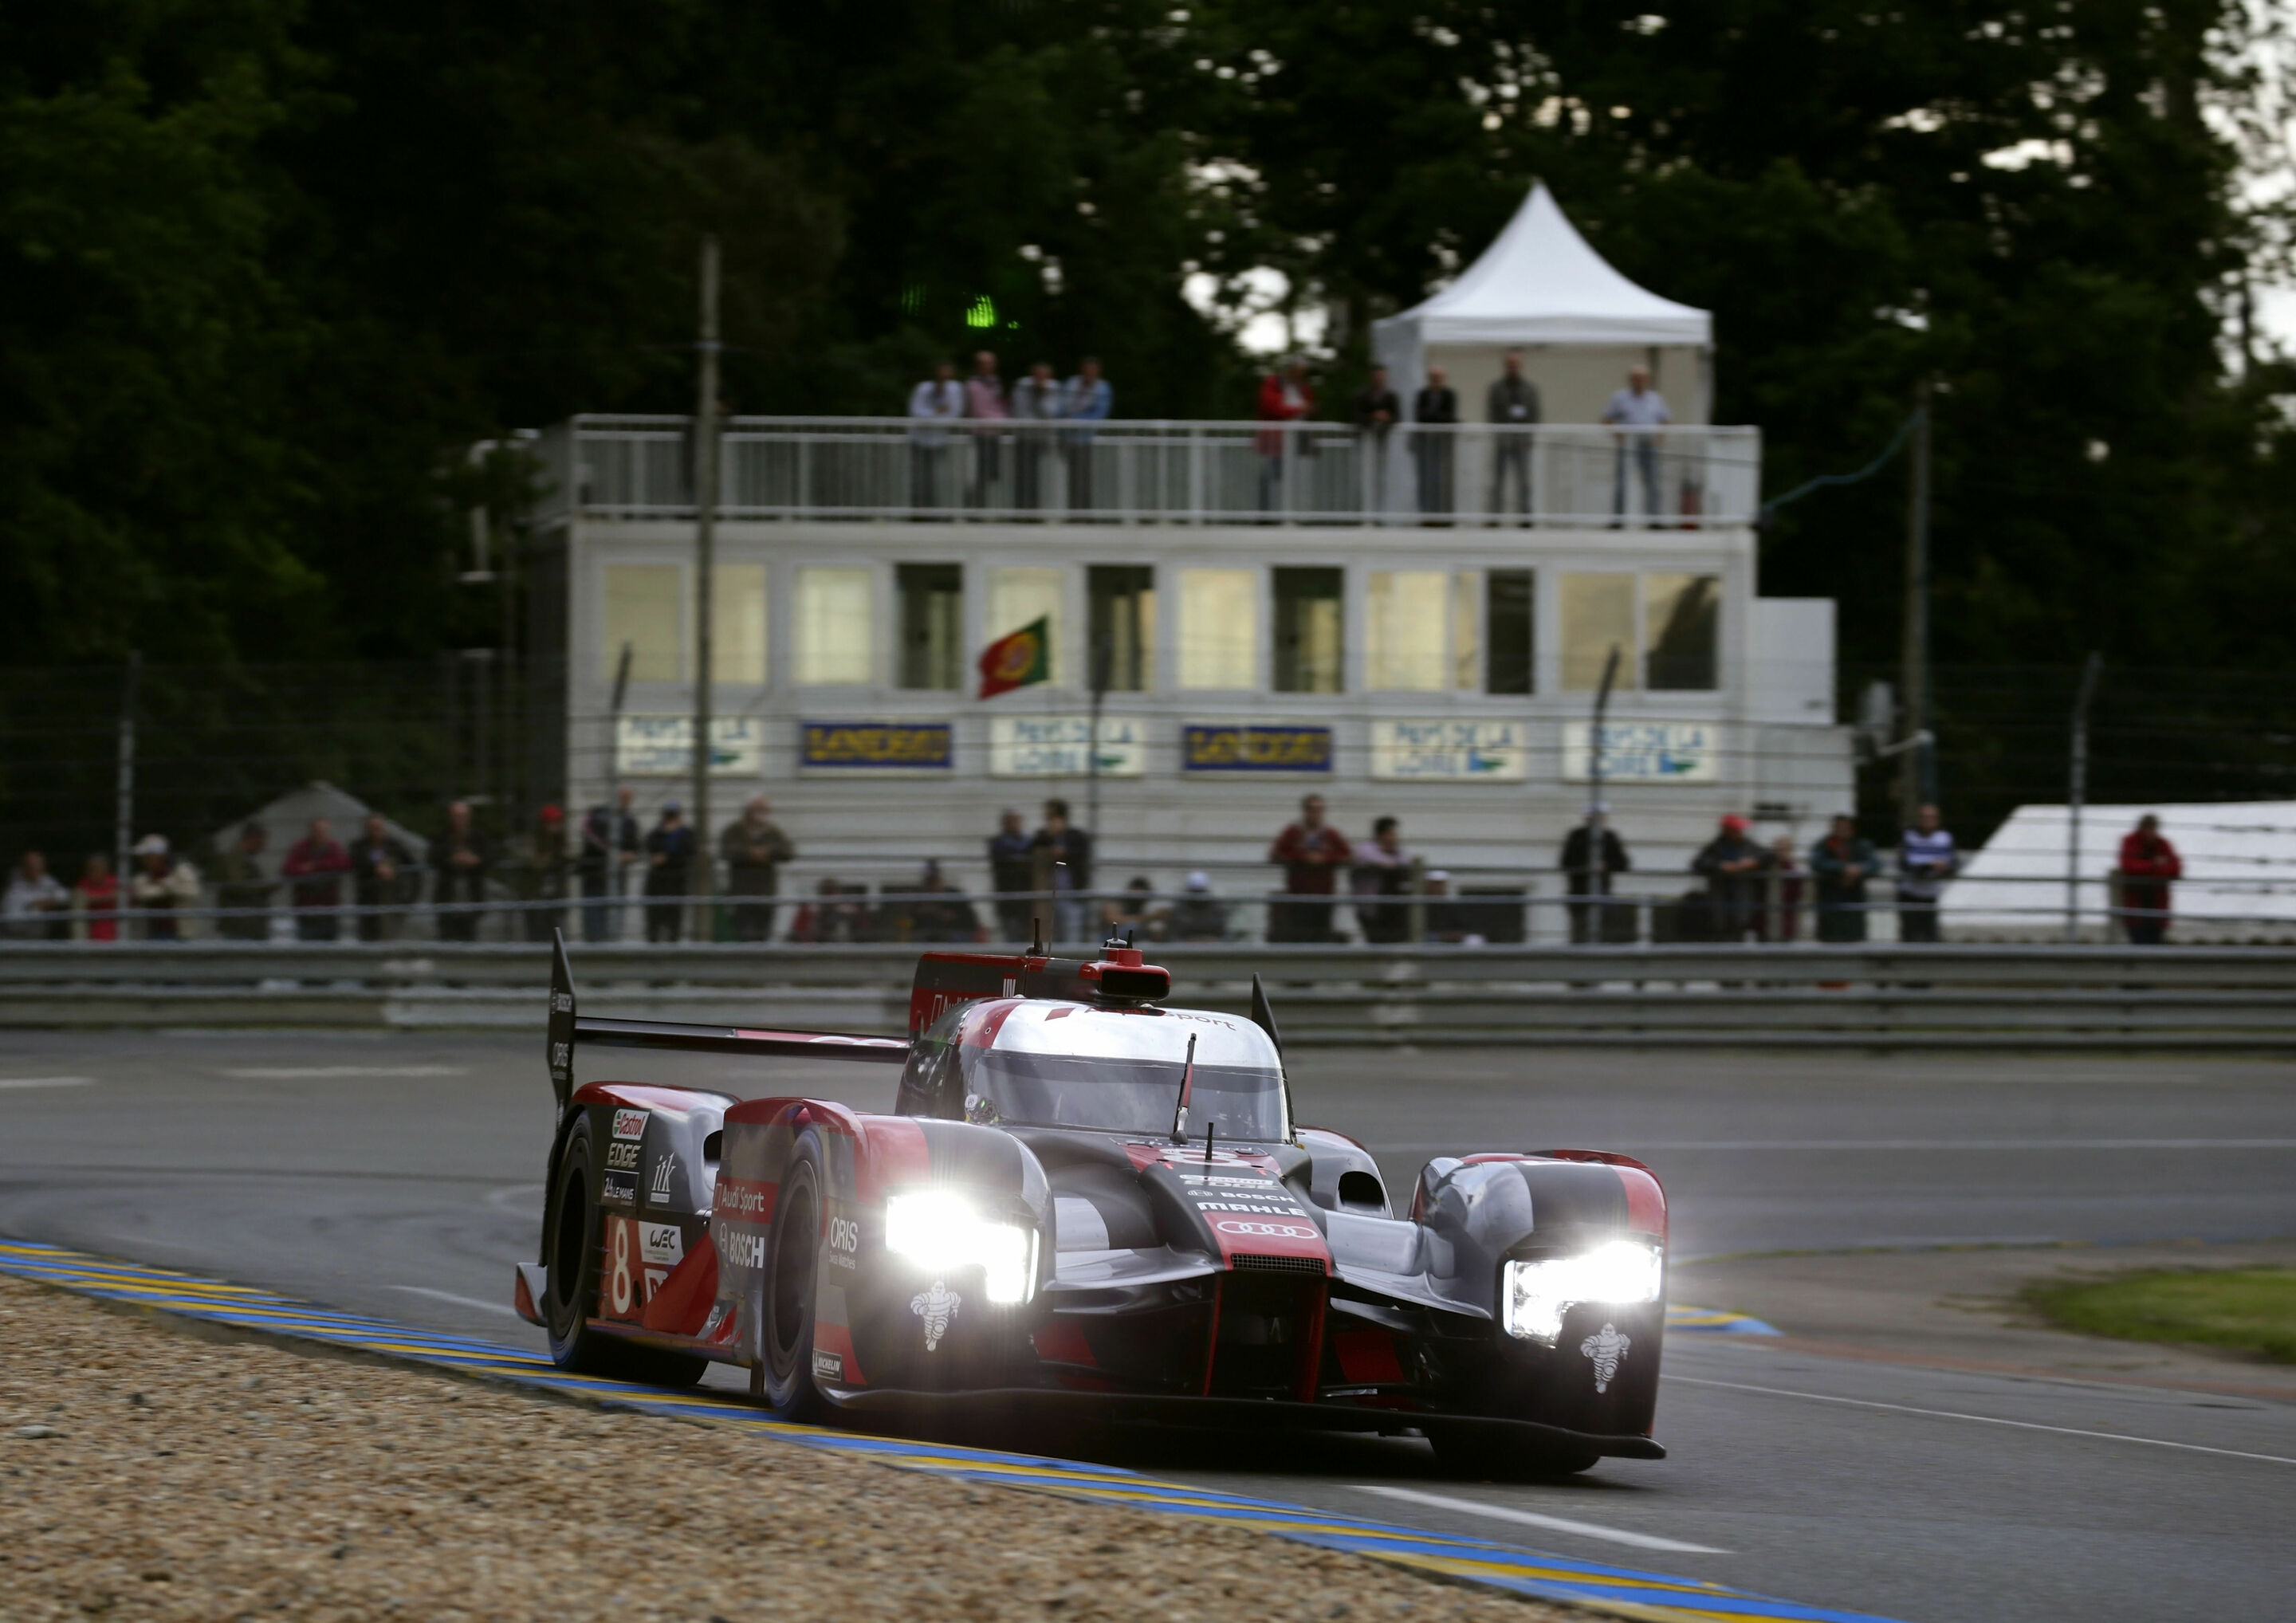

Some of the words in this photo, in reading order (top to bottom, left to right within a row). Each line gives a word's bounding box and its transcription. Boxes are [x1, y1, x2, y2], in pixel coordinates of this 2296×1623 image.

[619, 1113, 645, 1136] Castrol
[607, 1142, 642, 1168] EDGE
[651, 1152, 676, 1193] itk
[721, 1184, 739, 1208] Audi
[739, 1186, 765, 1216] Sport
[1197, 1202, 1308, 1217] MAHLE
[1220, 1192, 1296, 1203] BOSCH
[651, 1229, 675, 1250] WEC
[831, 1216, 858, 1253] ORIS
[729, 1232, 765, 1269] BOSCH
[612, 1219, 631, 1314] 8
